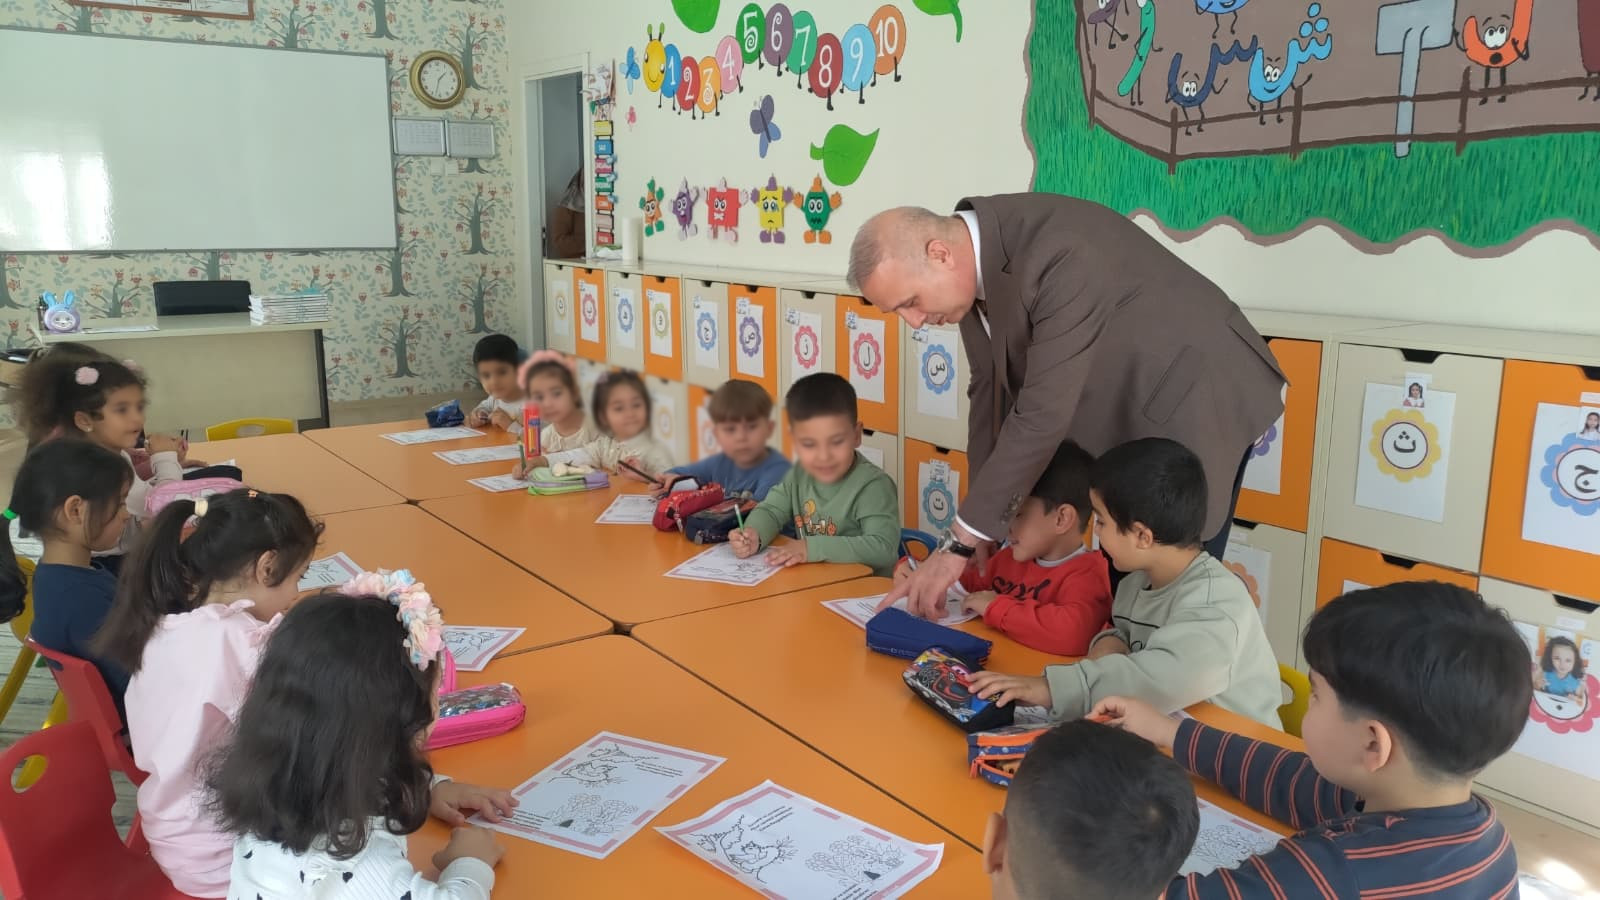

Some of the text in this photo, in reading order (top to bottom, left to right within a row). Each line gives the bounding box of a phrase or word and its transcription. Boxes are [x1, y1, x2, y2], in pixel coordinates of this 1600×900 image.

[669, 11, 899, 104] 1 2 3 4 5 6 7 8 9 10
[744, 331, 756, 345] ص
[803, 338, 809, 356] ز
[863, 344, 872, 367] ل
[930, 361, 946, 377] س
[1393, 430, 1417, 454] ث
[1574, 464, 1599, 494] ج
[932, 498, 944, 511] ت
